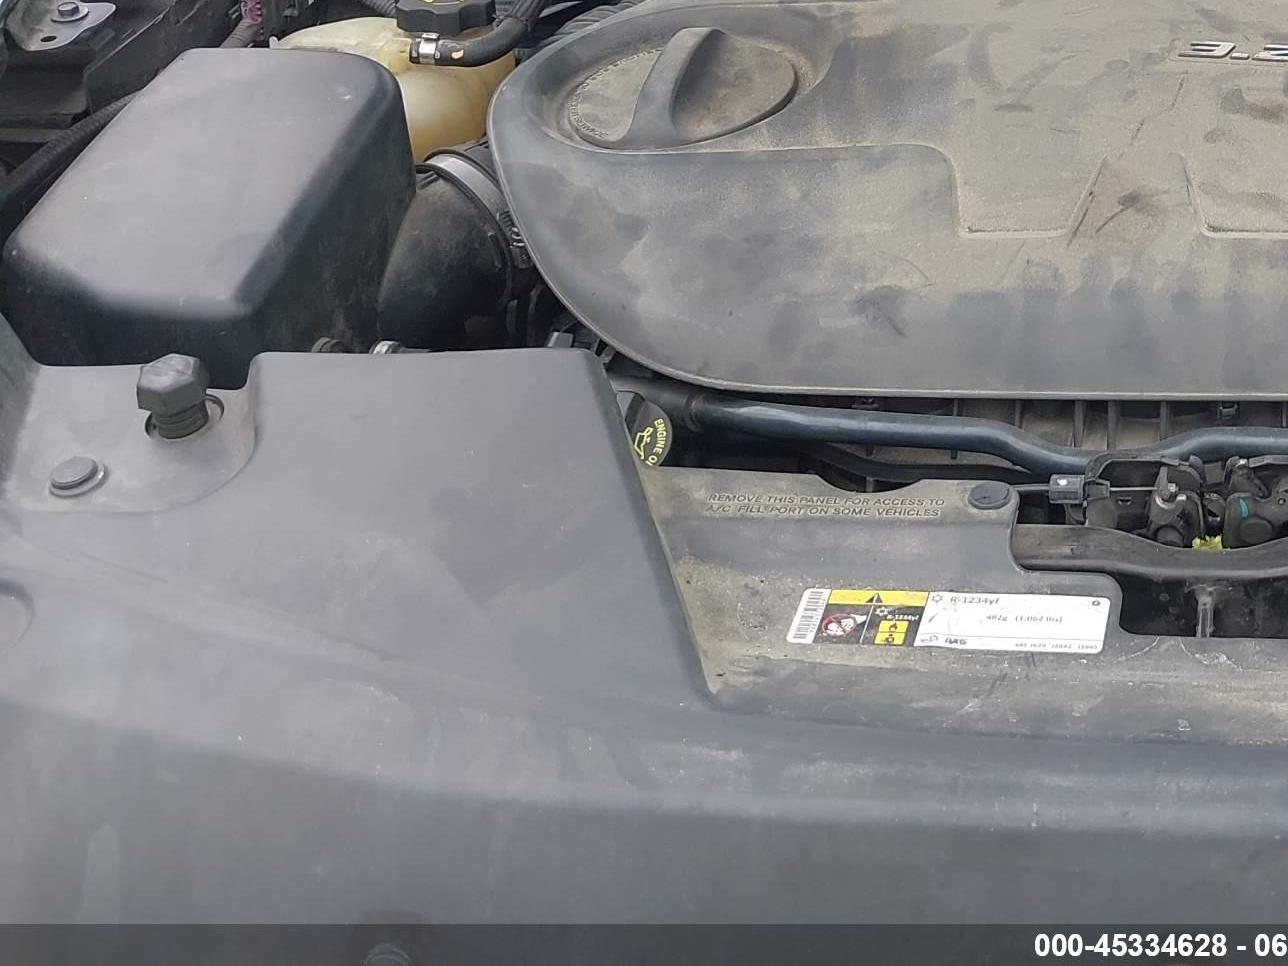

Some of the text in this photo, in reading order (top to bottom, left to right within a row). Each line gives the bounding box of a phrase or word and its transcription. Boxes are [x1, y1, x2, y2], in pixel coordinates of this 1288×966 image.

[646, 418, 667, 467] ENGINE OI
[707, 493, 945, 507] REMOVE THIS PANEL FOR ACCESS TO
[705, 504, 941, 518] A/C FILL PORT ON SOME VEHICLES
[950, 596, 1000, 606] R-1234yf
